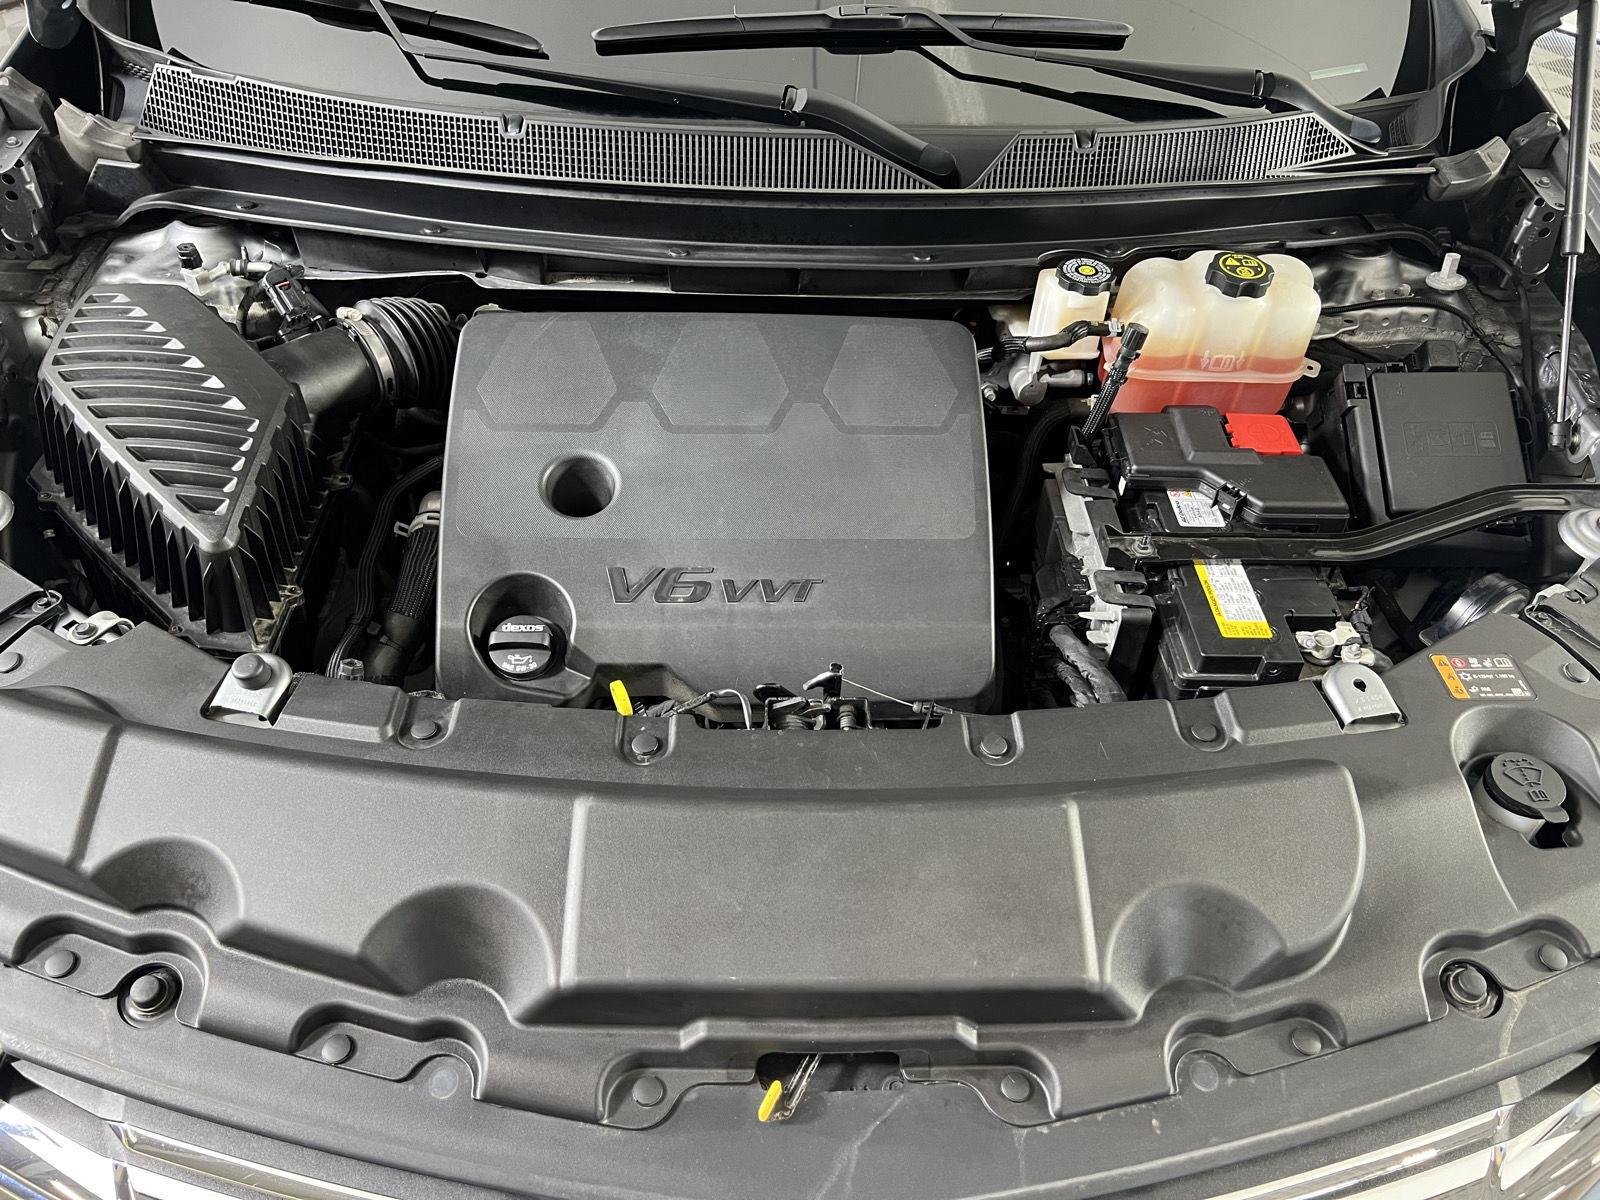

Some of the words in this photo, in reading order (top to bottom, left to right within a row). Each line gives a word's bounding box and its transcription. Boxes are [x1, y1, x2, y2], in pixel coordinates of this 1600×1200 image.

[606, 566, 714, 604] V6
[721, 578, 824, 604] VVT
[501, 622, 545, 632] dexos
